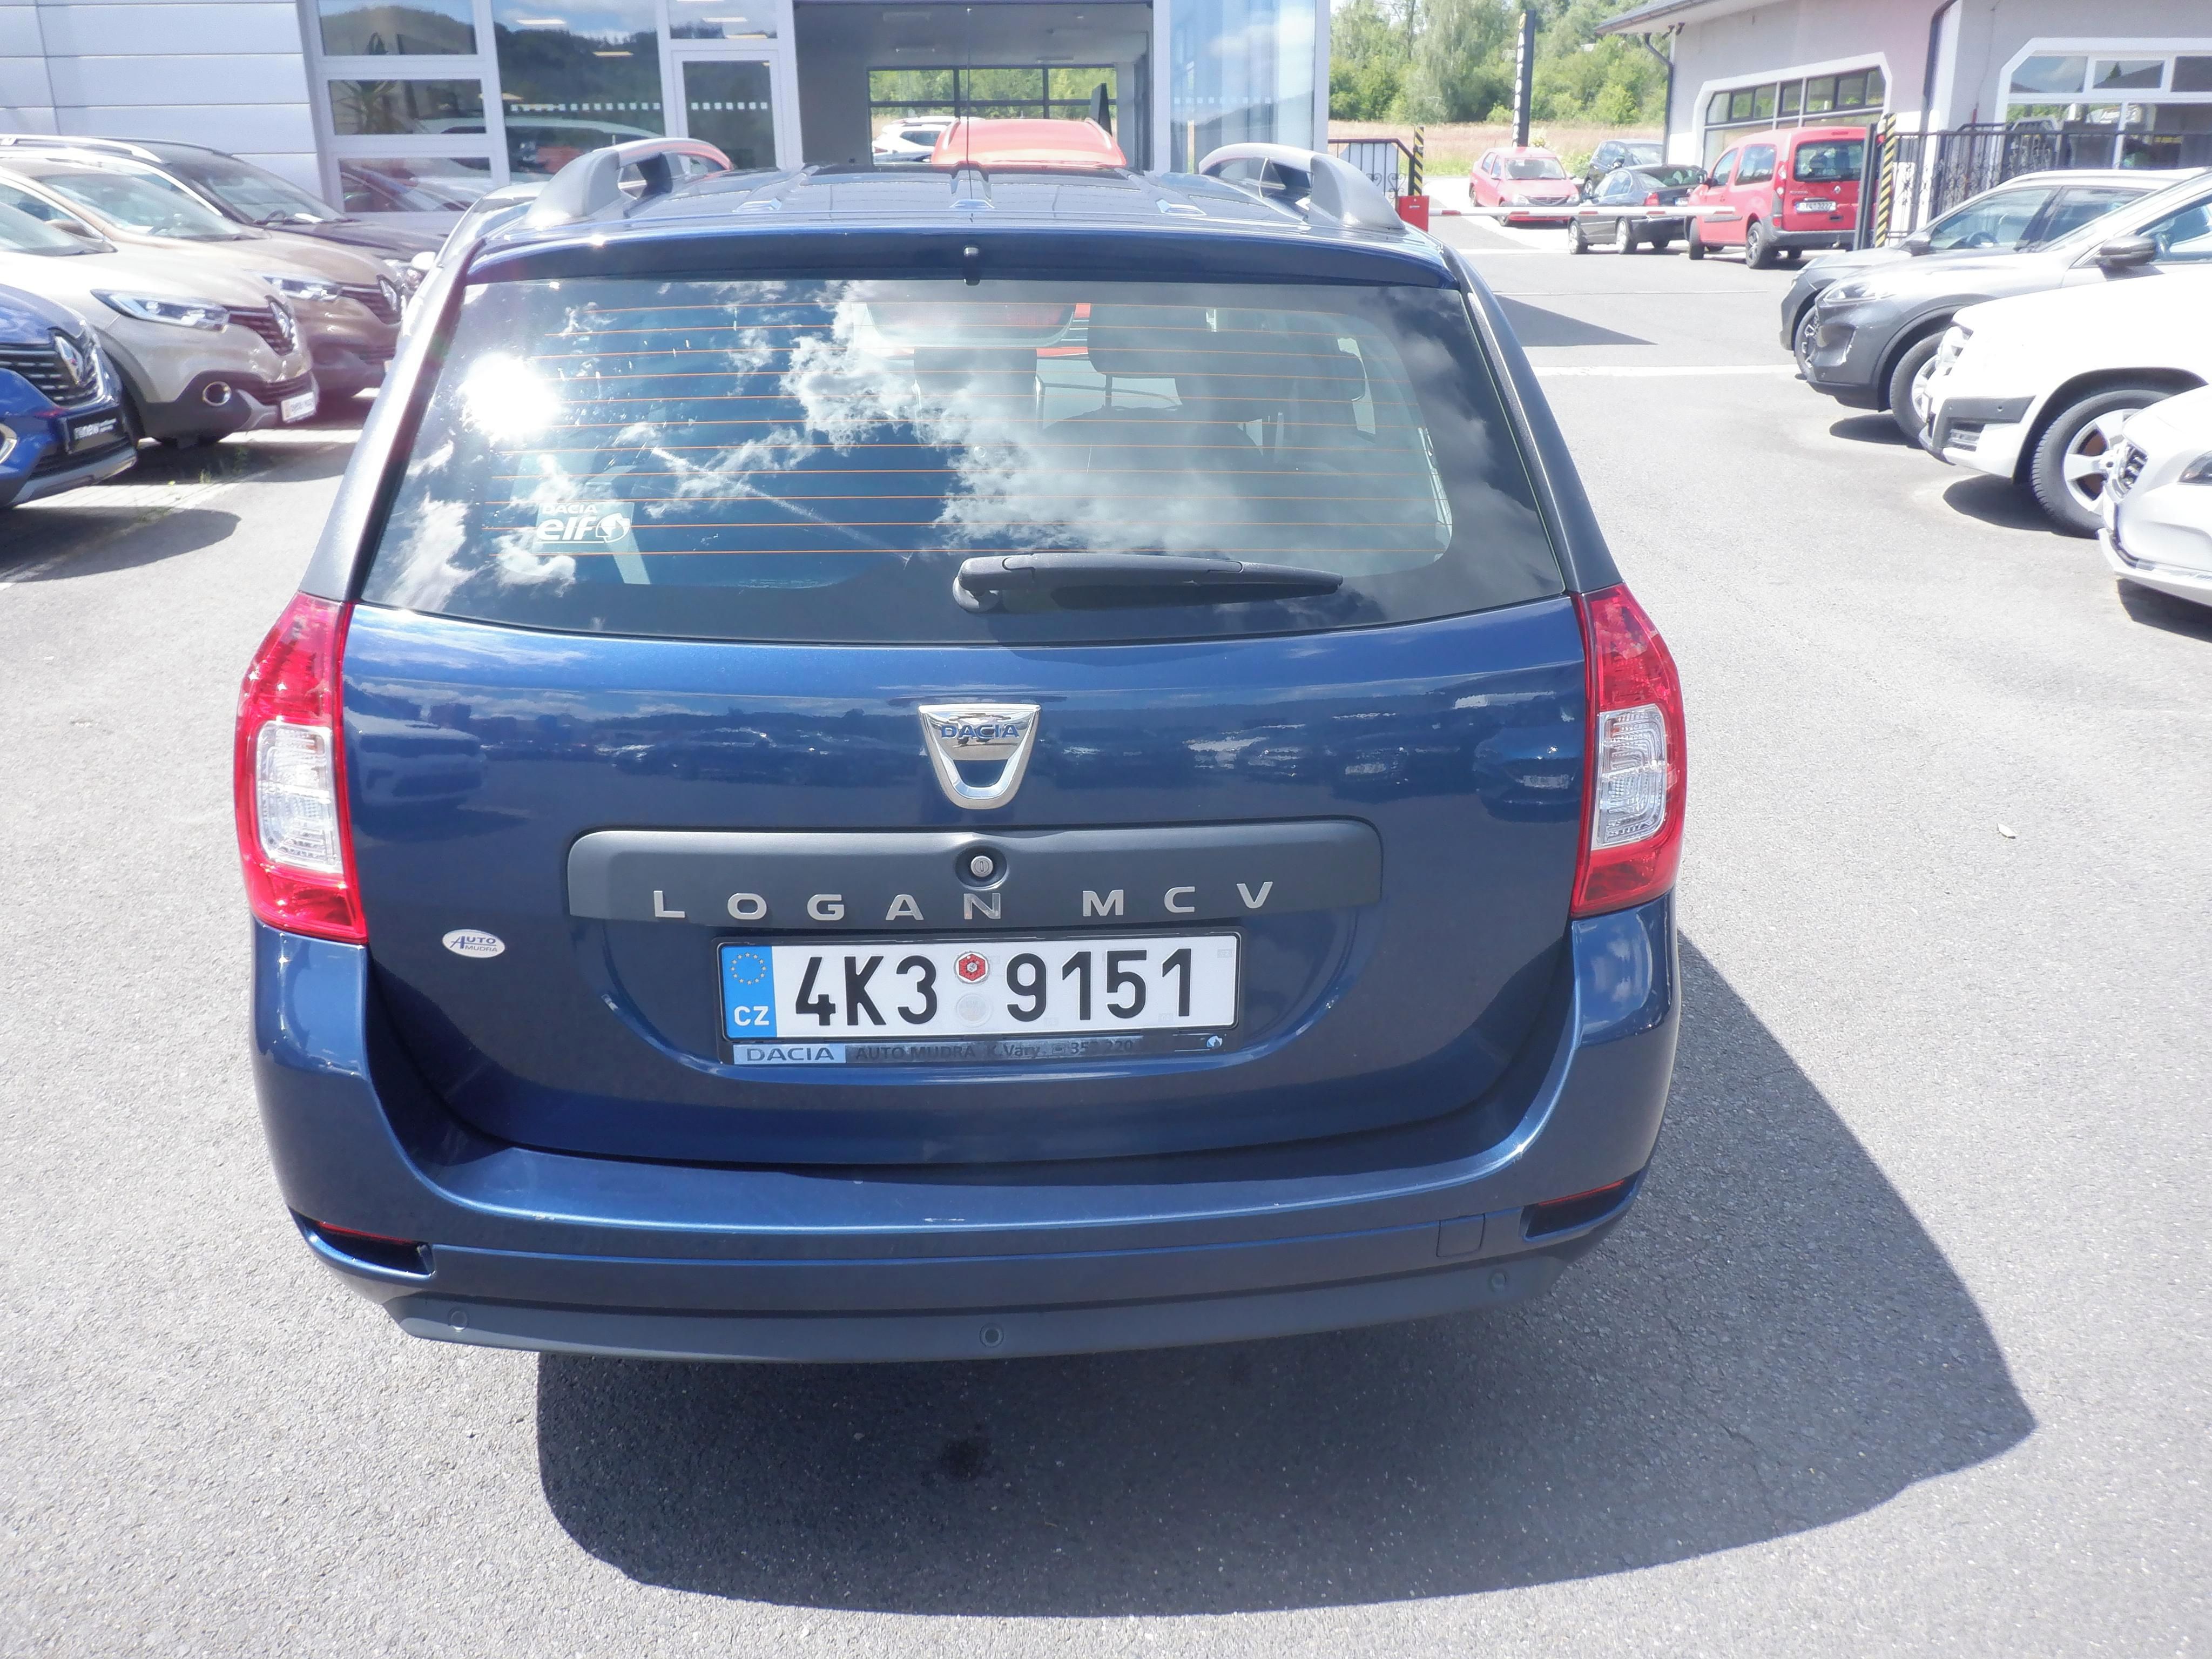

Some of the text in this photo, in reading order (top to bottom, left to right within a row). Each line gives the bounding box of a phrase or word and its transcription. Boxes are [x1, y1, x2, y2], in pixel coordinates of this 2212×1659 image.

[542, 503, 597, 513] DACIA
[536, 516, 597, 540] elf
[941, 724, 1020, 739] DACIA
[653, 881, 1273, 920] LOGAN MCV
[450, 936, 496, 949] AUTO
[795, 948, 1191, 1026] 4K3 9151
[734, 1006, 770, 1026] CZ
[747, 1047, 834, 1061] DACIA
[856, 1046, 906, 1060] AUTO
[910, 1045, 976, 1058] MUDRA
